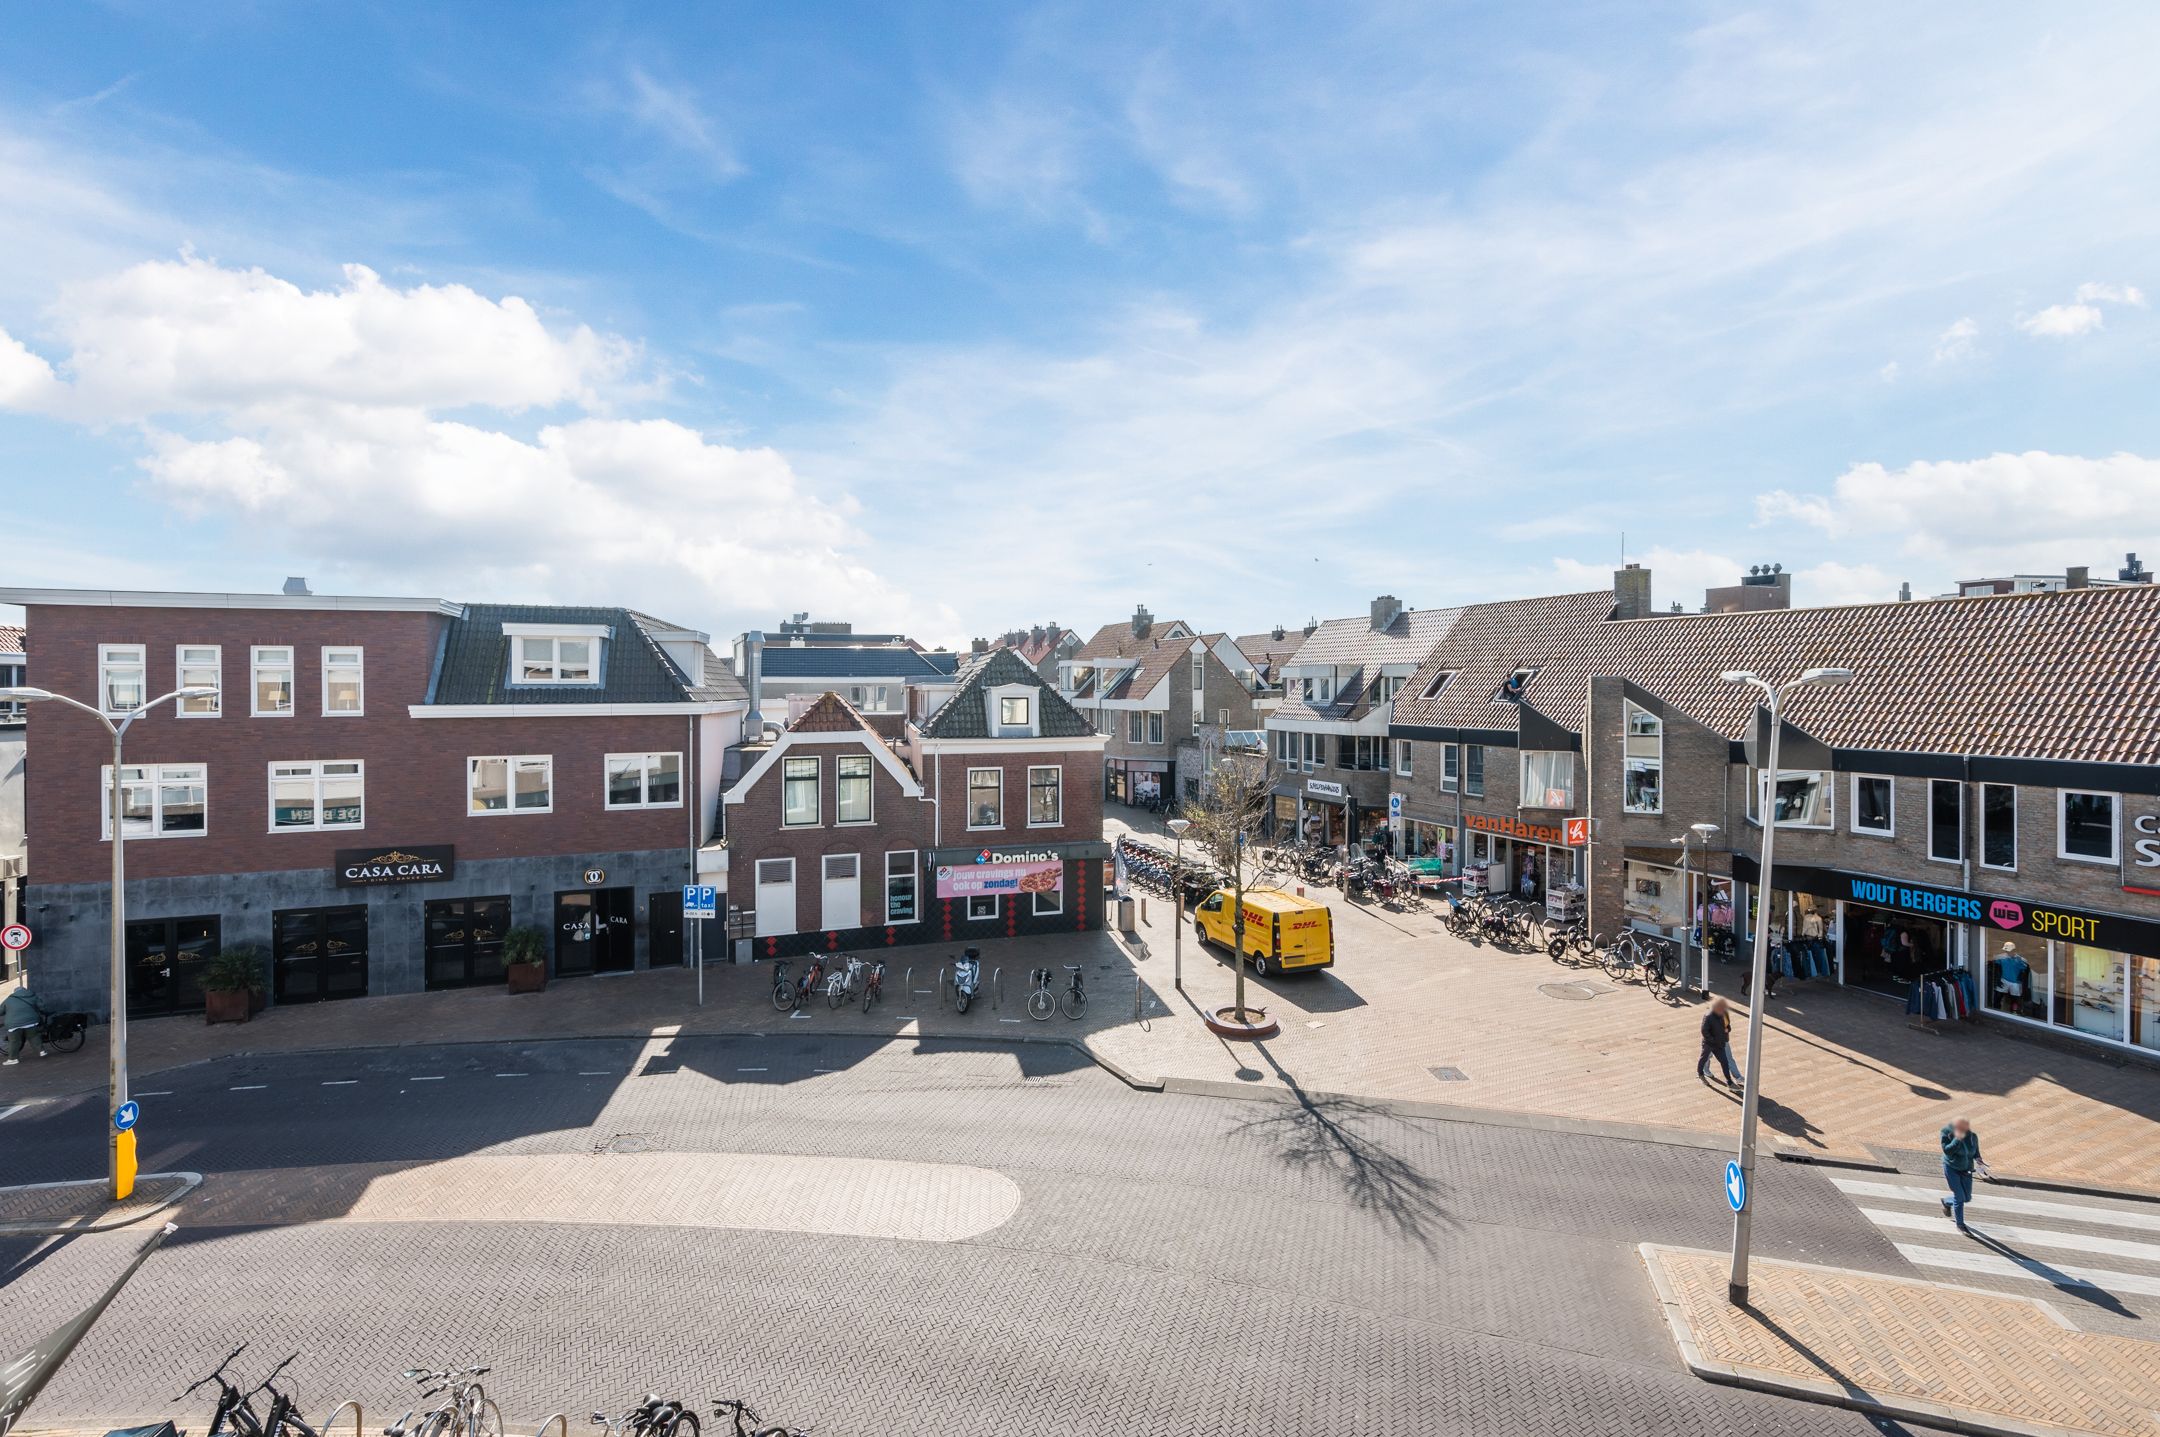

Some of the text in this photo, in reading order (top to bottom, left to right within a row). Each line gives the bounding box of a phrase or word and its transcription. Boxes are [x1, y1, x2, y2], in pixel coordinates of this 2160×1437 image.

[1465, 815, 1562, 843] vanHaren
[992, 850, 1059, 864] Domino's
[345, 864, 443, 878] CASA CARA
[953, 871, 975, 881] jouw
[976, 869, 1013, 879] cravings
[1014, 868, 1026, 877] nu
[953, 879, 1018, 891] ook op zondag!
[687, 888, 696, 900] P
[702, 888, 712, 900] P
[1851, 879, 1982, 921] WOUT BERGERS
[562, 916, 628, 931] CASA CARA
[1241, 909, 1265, 927] DHL
[1292, 921, 1318, 930] DHL
[2031, 910, 2100, 941] SPORT
